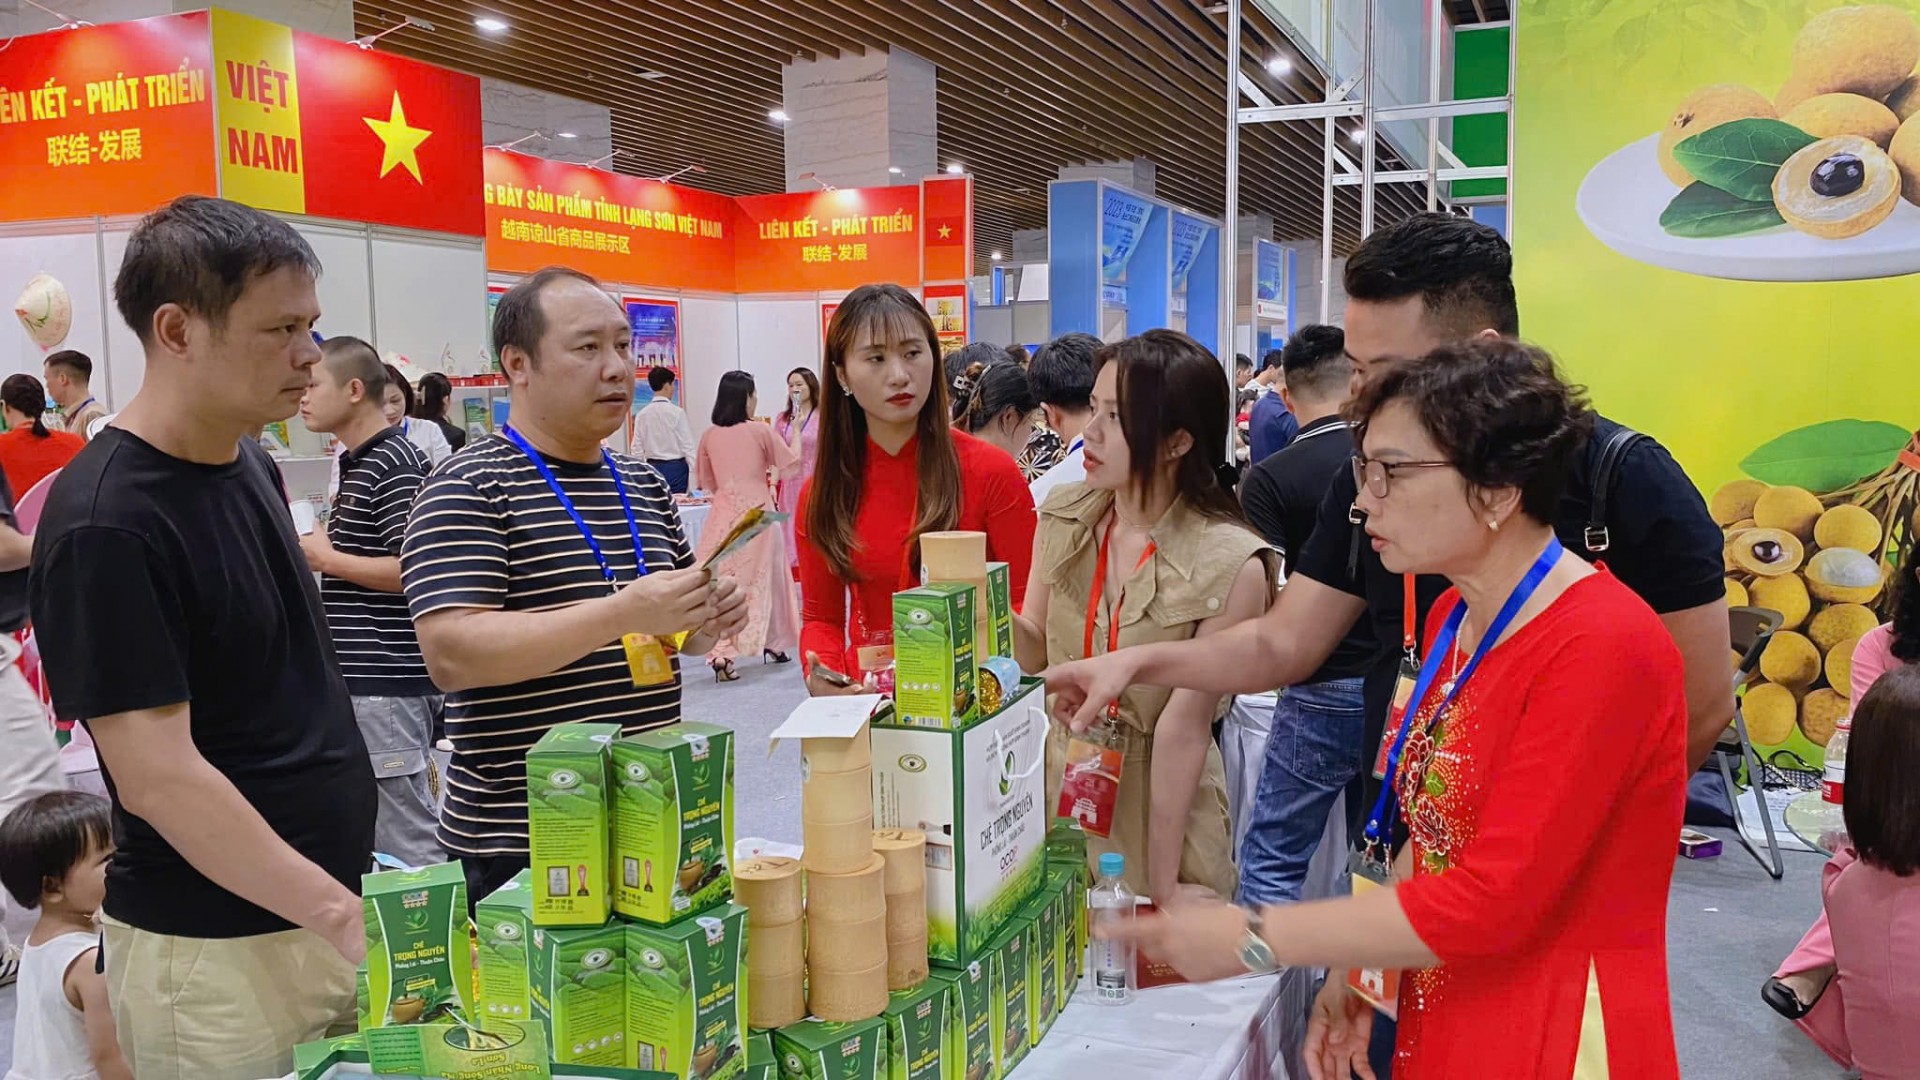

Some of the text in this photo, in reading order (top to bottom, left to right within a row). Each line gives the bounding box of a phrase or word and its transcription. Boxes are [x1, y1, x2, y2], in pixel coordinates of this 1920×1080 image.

[30, 77, 67, 121] KẾT
[73, 98, 82, 107] -
[86, 72, 139, 115] PHÁT
[144, 56, 205, 108] TRIỂN
[226, 60, 289, 113] VIỆT
[46, 128, 142, 167] 联结-发展
[227, 127, 298, 174] NAM
[496, 182, 523, 208] BÀY
[527, 185, 553, 213] SẢN
[556, 190, 592, 219] PHẨM
[594, 196, 621, 223] TỈNH
[623, 206, 652, 230] LẠNG
[654, 210, 676, 232] SƠN
[678, 213, 698, 239] VIỆT
[700, 221, 723, 239] NAM
[759, 218, 790, 239] LIÊN
[793, 215, 818, 238] KẾT
[832, 214, 867, 236] PHÁT
[871, 208, 912, 233] TRIỂN
[501, 218, 631, 254] 越南谅山省商品展示区
[802, 244, 868, 263] 联结-发展
[1000, 845, 1018, 870] OCOP
